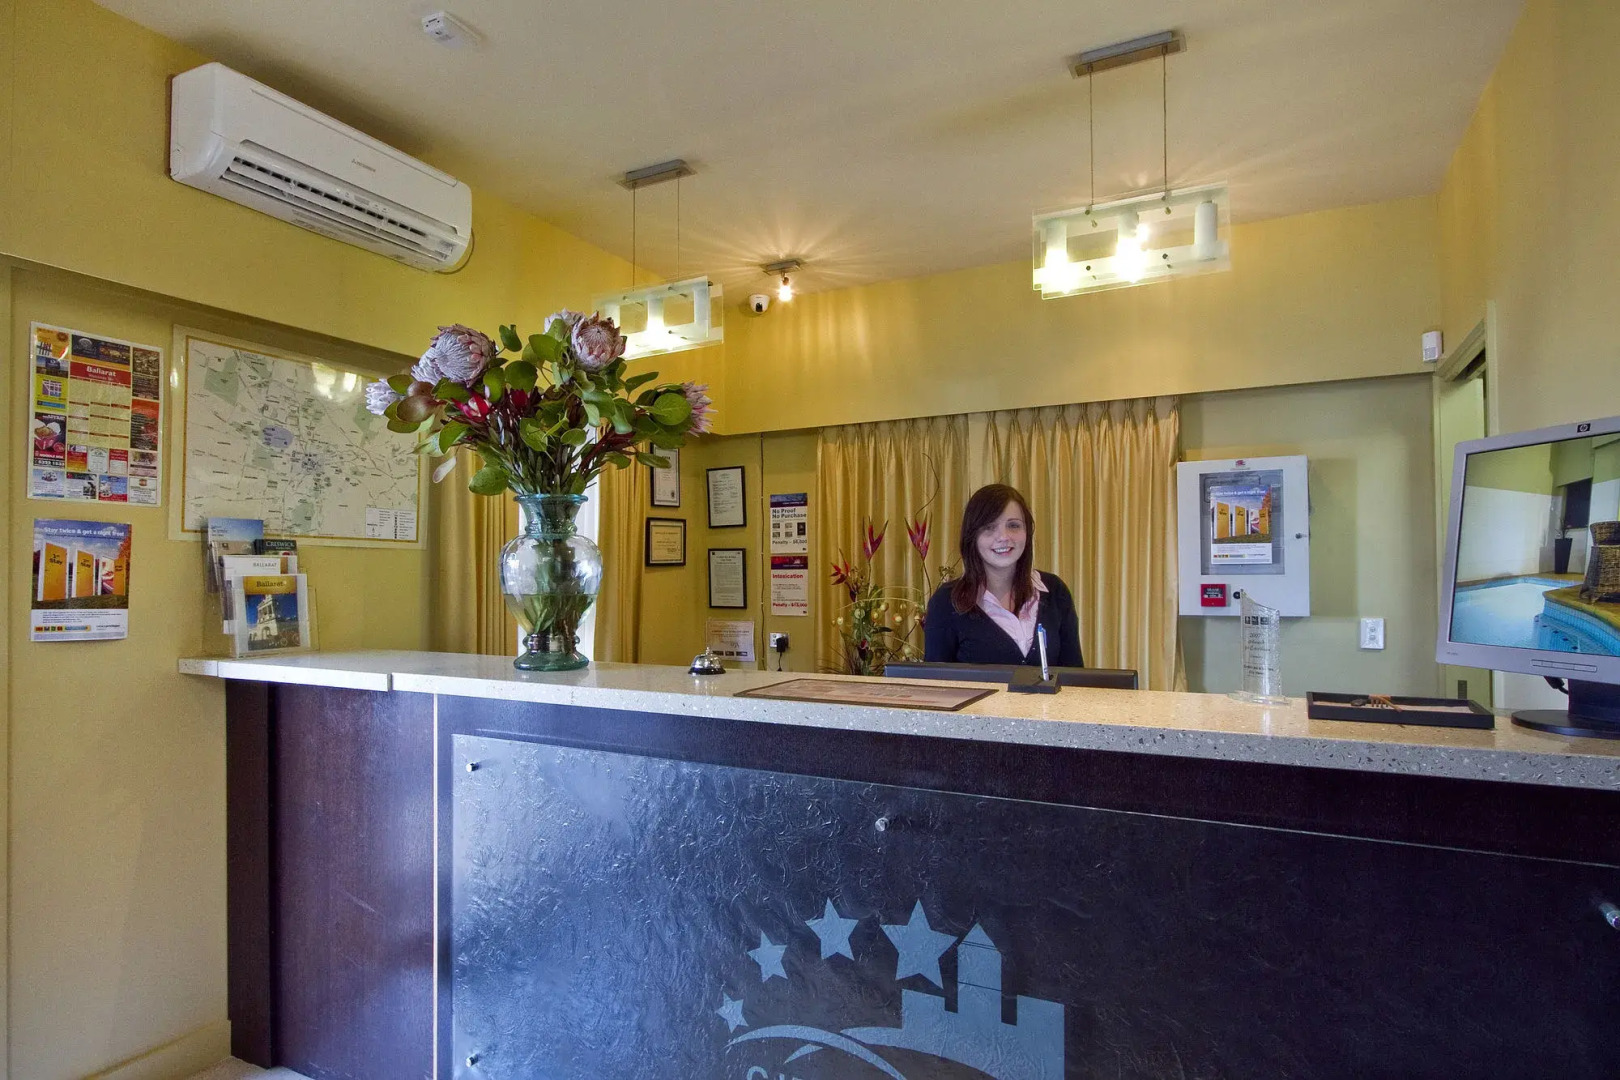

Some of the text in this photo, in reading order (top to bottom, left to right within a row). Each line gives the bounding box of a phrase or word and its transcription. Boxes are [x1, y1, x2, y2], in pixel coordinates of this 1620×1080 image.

[86, 366, 116, 376] Ballarat
[44, 526, 58, 536] Stay
[50, 558, 62, 566] Stay
